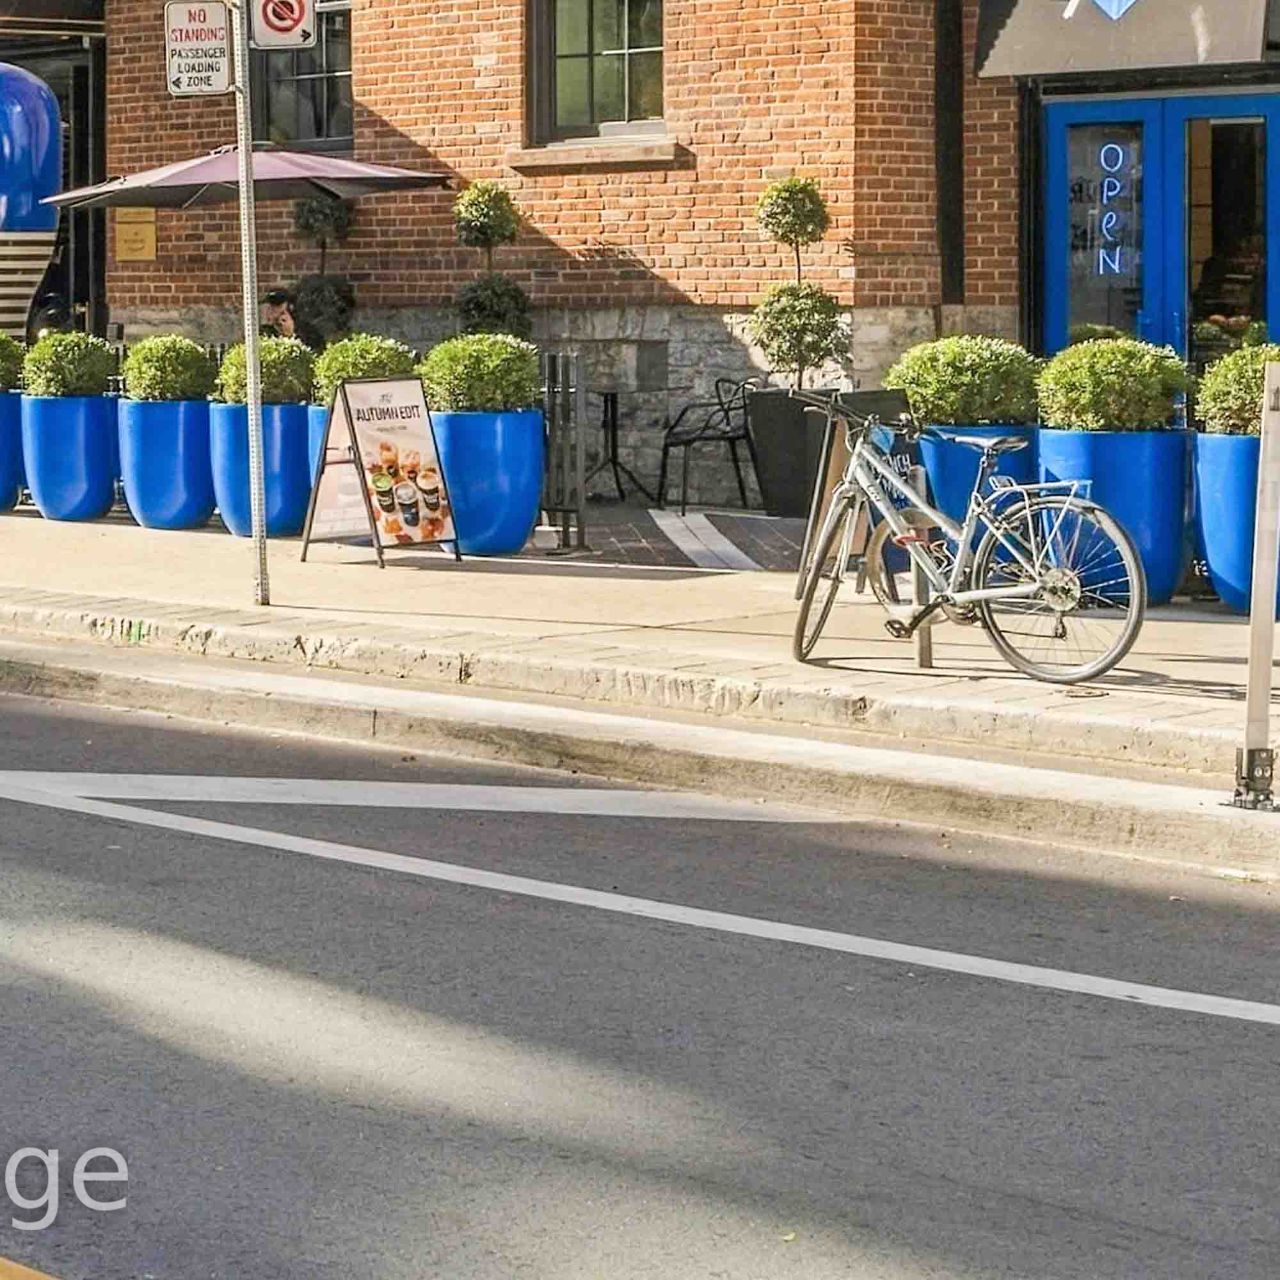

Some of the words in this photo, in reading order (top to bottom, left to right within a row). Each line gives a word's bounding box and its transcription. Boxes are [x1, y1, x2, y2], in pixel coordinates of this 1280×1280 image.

[188, 9, 206, 24] NO
[171, 27, 225, 43] STANDING
[171, 47, 226, 60] PASSENGER
[178, 61, 221, 74] LOADING
[187, 75, 212, 87] ZONE
[356, 406, 399, 422] AUTUMN
[399, 404, 421, 420] EDIT
